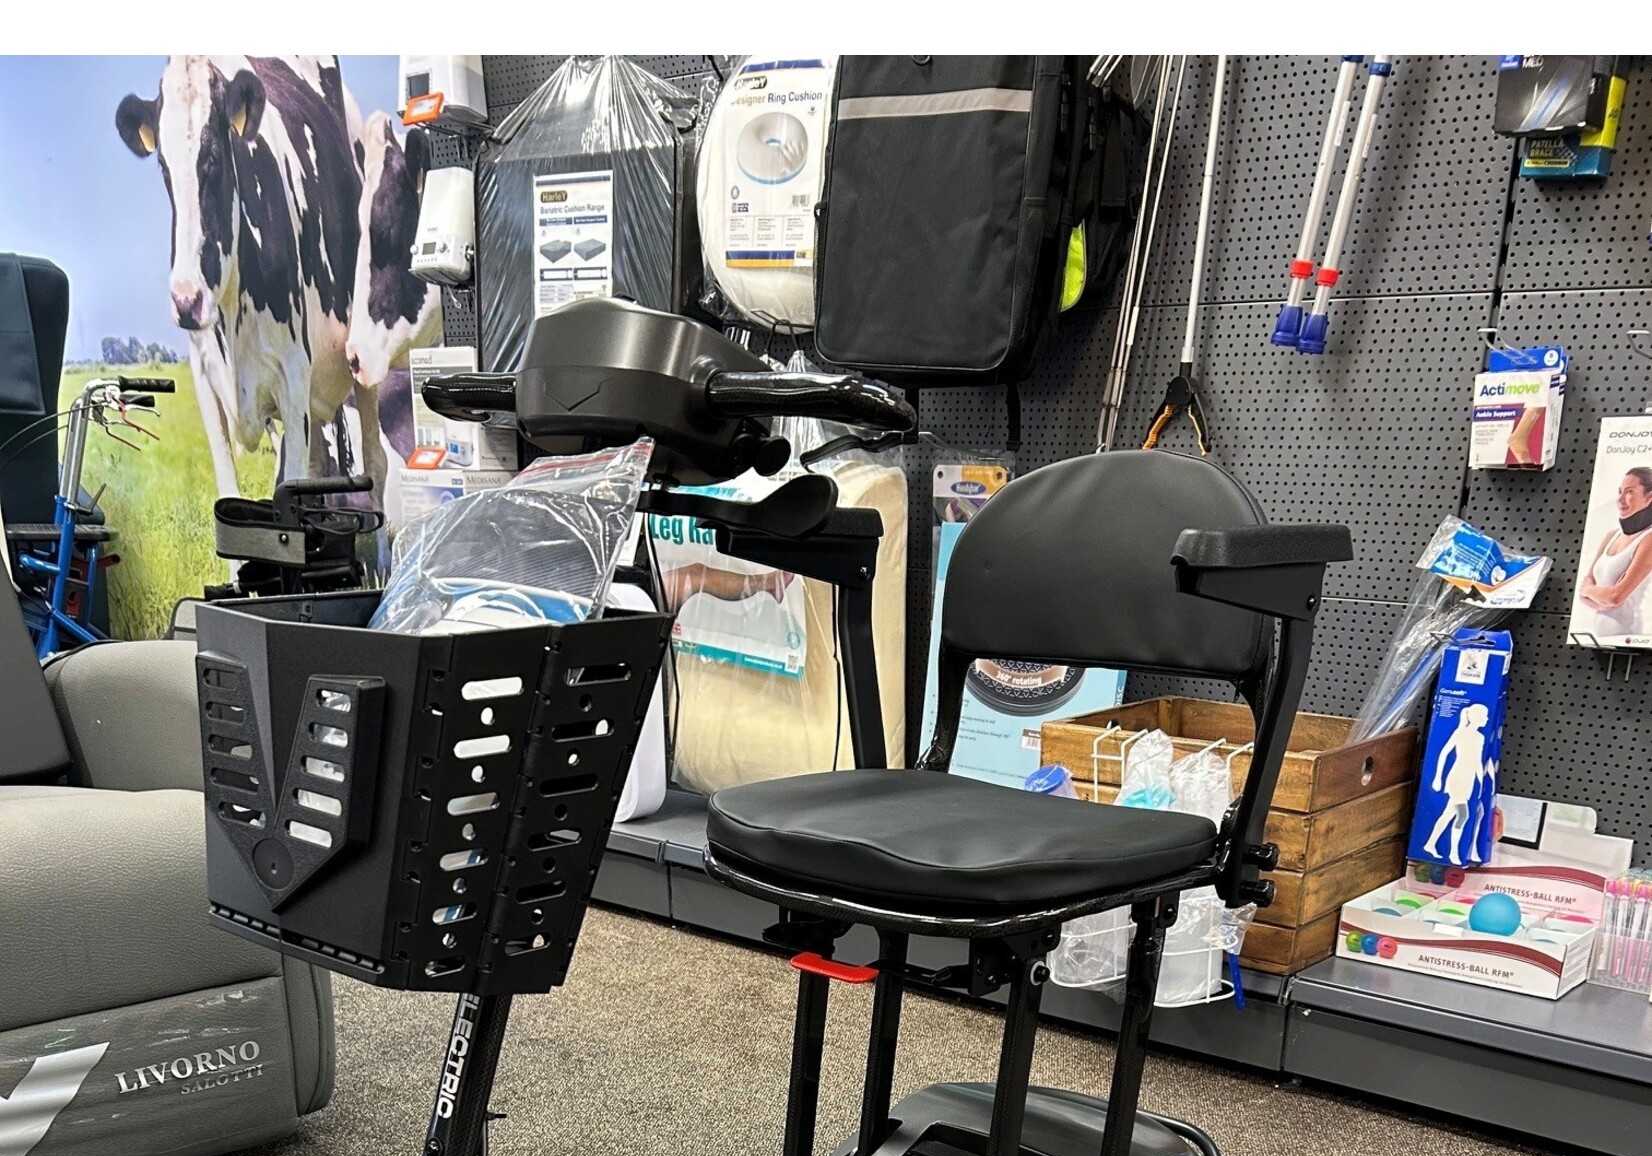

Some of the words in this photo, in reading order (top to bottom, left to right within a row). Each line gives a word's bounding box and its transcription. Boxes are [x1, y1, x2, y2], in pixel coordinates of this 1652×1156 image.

[768, 92, 787, 105] Ring
[788, 91, 823, 102] Cushion
[1531, 140, 1563, 149] PATELLA
[1530, 148, 1554, 157] BRACE
[540, 206, 563, 214] Bariatric
[564, 205, 585, 213] Cushion
[587, 204, 605, 213] Range
[1480, 382, 1541, 397] Actimove
[1475, 410, 1493, 418] Ankle
[1493, 410, 1516, 419] Support
[649, 513, 684, 546] Leg
[1012, 676, 1042, 687] rotating
[1484, 883, 1553, 902] ANTISTRESS-BALL
[1418, 954, 1489, 975] ANTISTRESS-BALL
[115, 1040, 260, 1094] LIVORNO
[180, 1063, 264, 1095] SALOTTI
